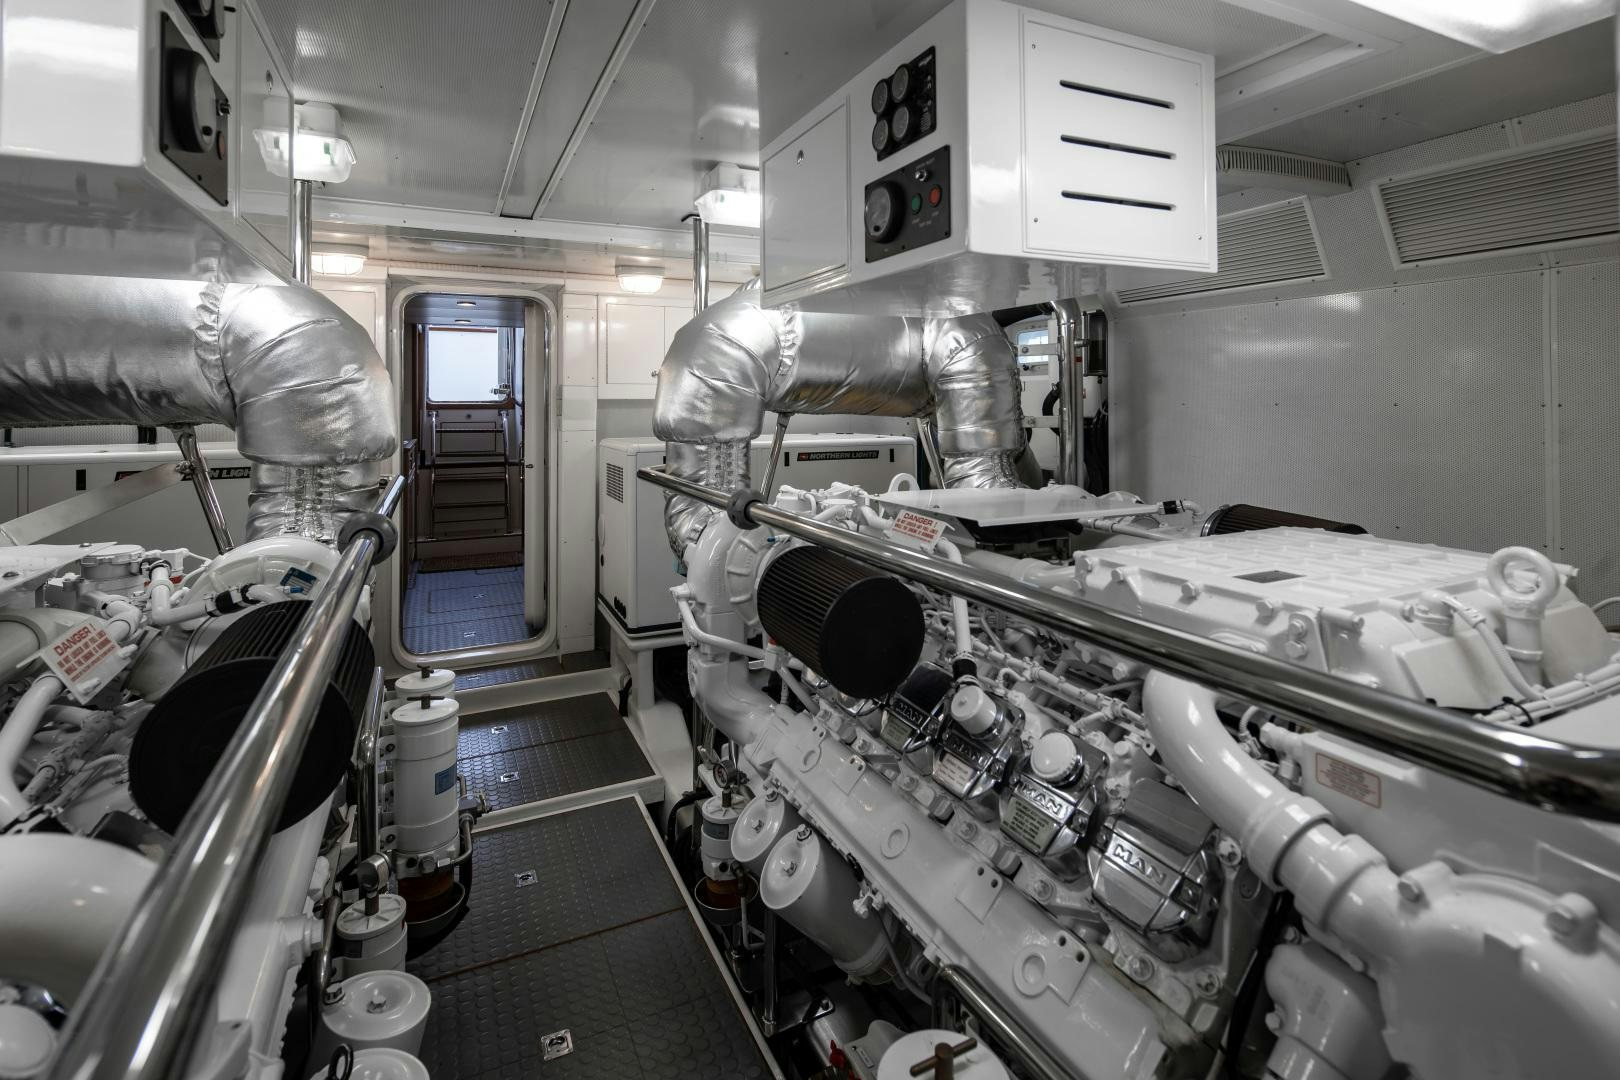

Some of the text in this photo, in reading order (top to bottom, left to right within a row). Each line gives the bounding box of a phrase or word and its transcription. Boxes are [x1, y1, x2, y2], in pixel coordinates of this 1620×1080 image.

[809, 452, 851, 461] NORTHERN
[903, 512, 934, 526] DANGER
[53, 626, 92, 657] DANGER
[895, 701, 924, 725] MAN
[1020, 782, 1064, 816] MAN
[1112, 843, 1168, 887] MAN
